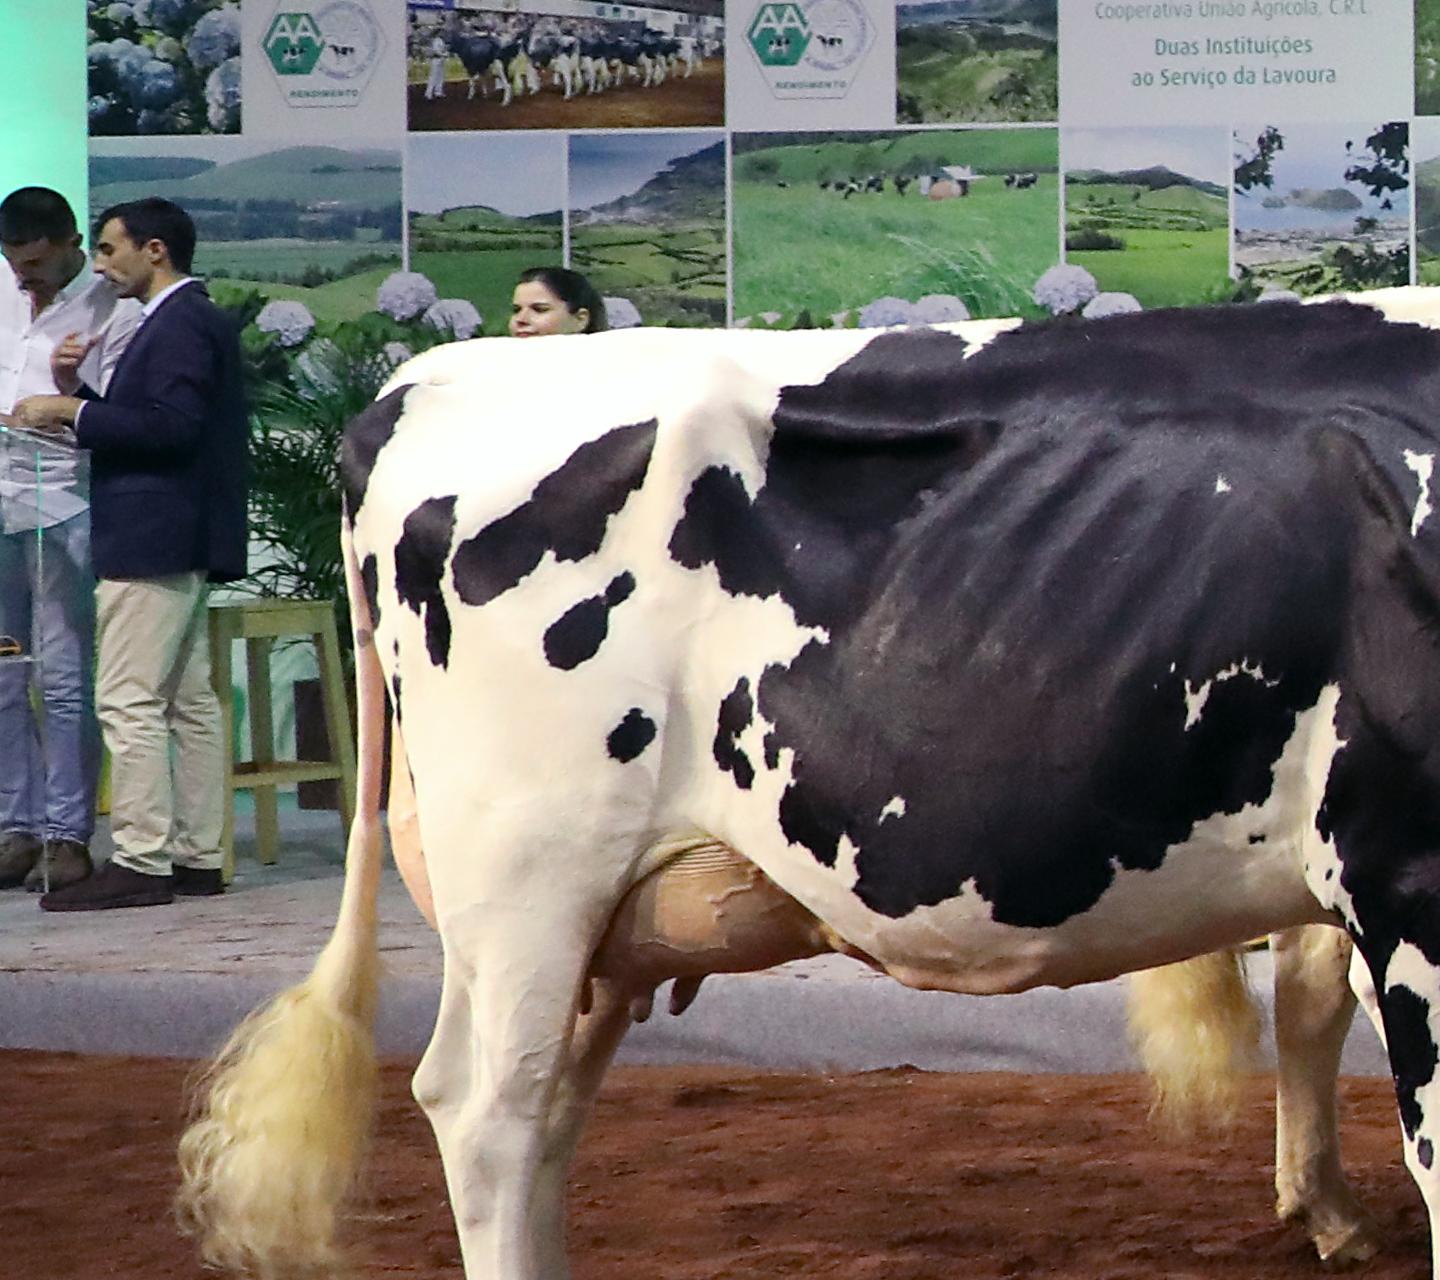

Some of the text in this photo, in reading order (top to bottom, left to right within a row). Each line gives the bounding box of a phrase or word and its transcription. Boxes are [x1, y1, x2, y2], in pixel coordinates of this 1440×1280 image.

[1095, 0, 1192, 22] Cooperativa
[1199, 0, 1246, 18] União
[1154, 36, 1313, 58] Duas Instituições
[775, 80, 847, 89] RENDIMENTO
[1132, 66, 1336, 89] ao Serviço da Lavoura
[289, 89, 358, 98] RENDIMENTO
